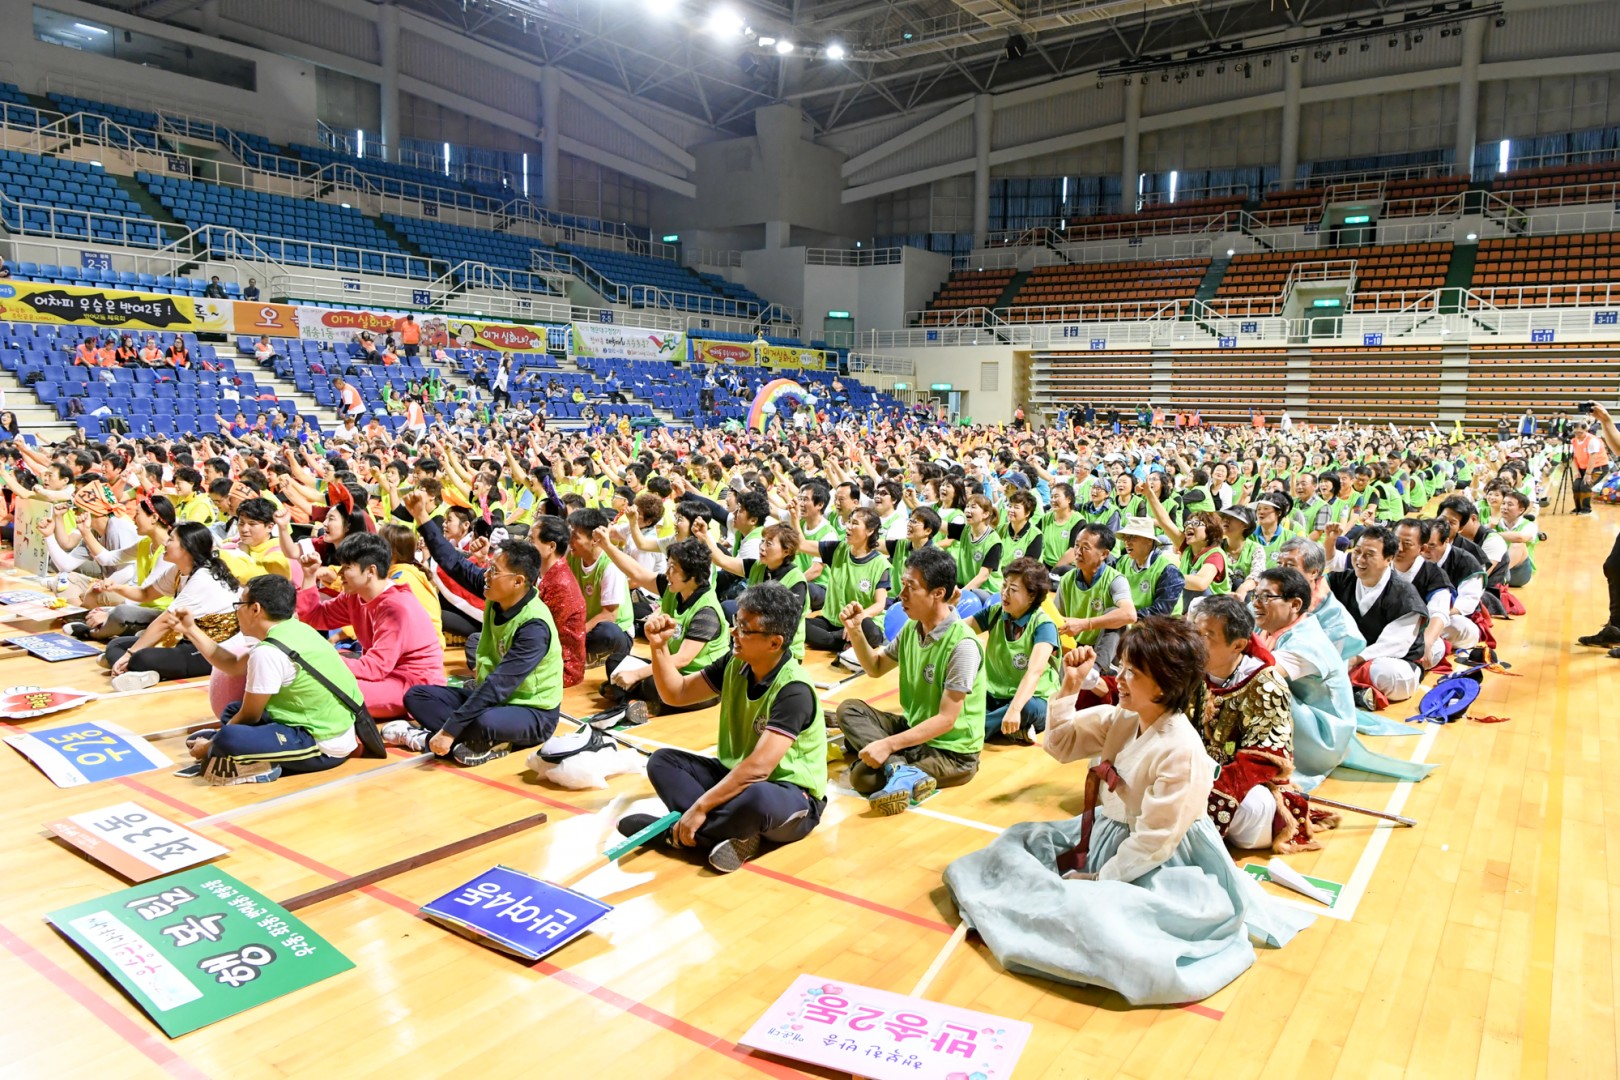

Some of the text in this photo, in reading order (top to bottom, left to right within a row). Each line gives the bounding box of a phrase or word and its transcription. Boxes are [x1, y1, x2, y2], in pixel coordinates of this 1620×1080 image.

[87, 259, 108, 271] 2-3
[34, 294, 74, 308] 어차피
[80, 298, 115, 314] 우승은
[120, 301, 163, 317] 반여2동
[415, 295, 428, 305] 2-4
[331, 315, 396, 329] 이거 실화냐?
[601, 314, 612, 323] 2-5
[302, 326, 336, 340] 재송1동
[483, 330, 500, 340] 이거
[501, 332, 529, 345] 실화냐?
[1535, 334, 1551, 342] 1-11
[1365, 337, 1381, 345] 1-10
[48, 729, 131, 765] 우2동
[93, 813, 198, 861] 좌3동
[200, 879, 316, 957] 우2동, 좌3동, 반여4동, 반송2동
[453, 882, 578, 939] 반여4동
[803, 994, 979, 1060] 반송2동
[823, 1033, 922, 1070] 행복한 반송
